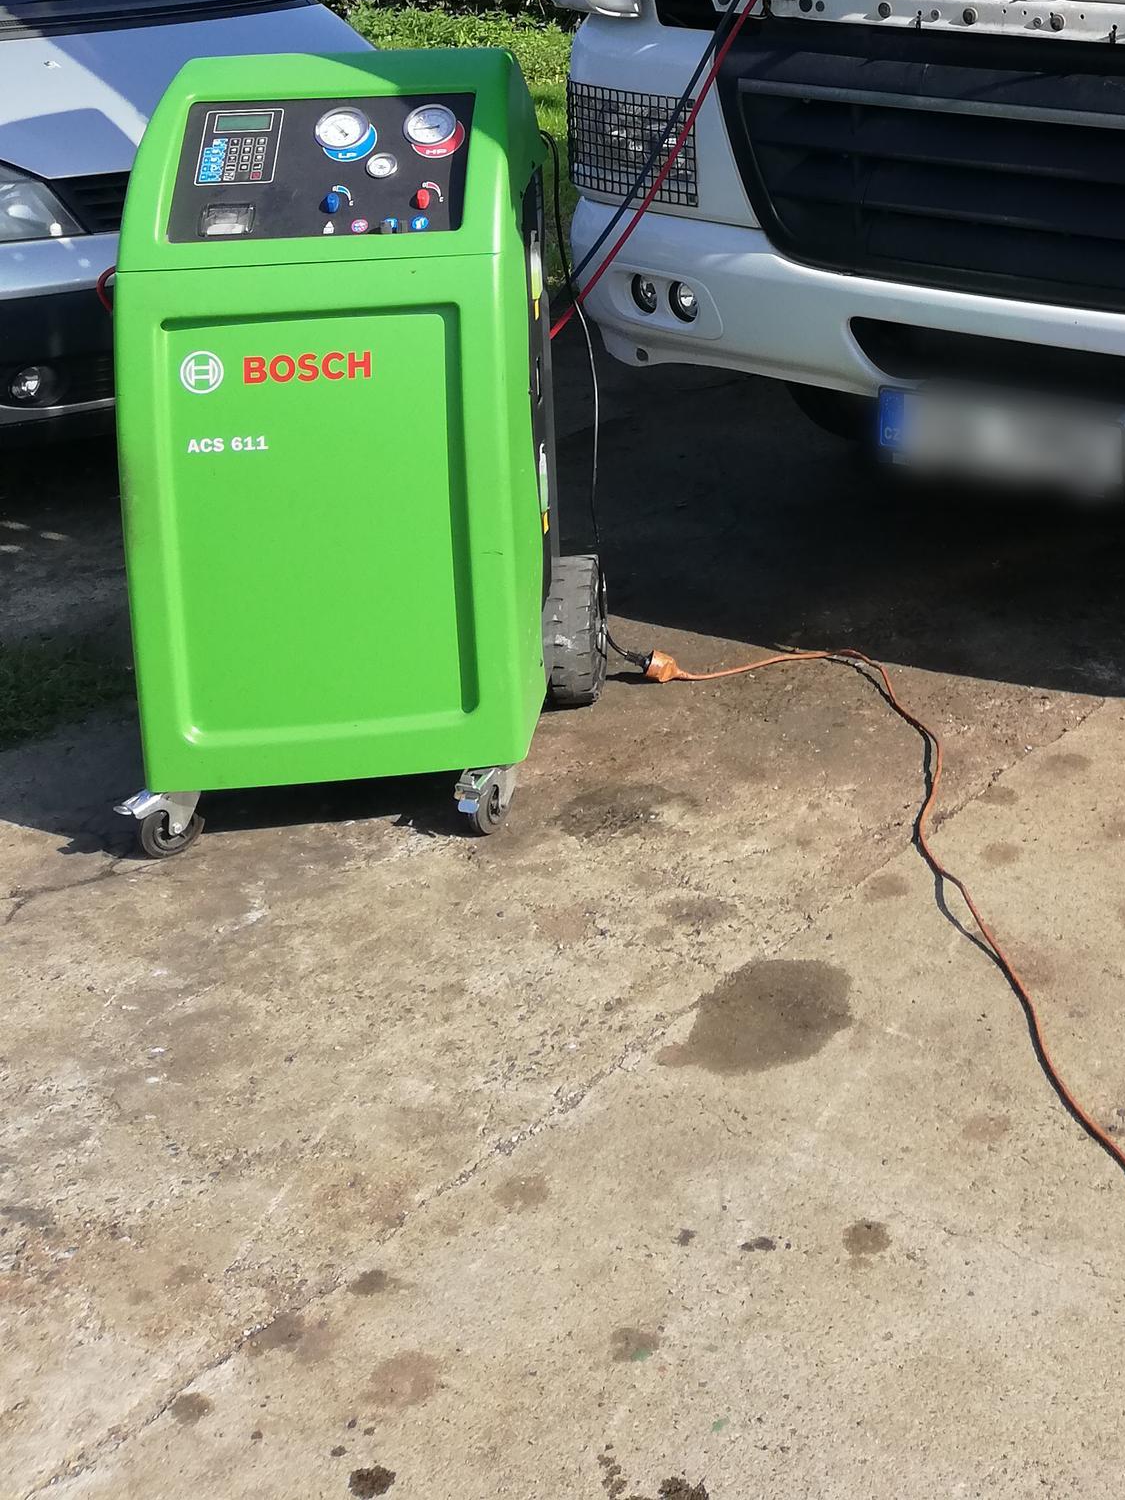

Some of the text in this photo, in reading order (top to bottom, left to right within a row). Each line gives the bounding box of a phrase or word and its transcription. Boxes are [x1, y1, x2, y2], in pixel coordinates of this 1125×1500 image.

[243, 351, 372, 385] BOSCH
[187, 436, 269, 453] ACS 611
